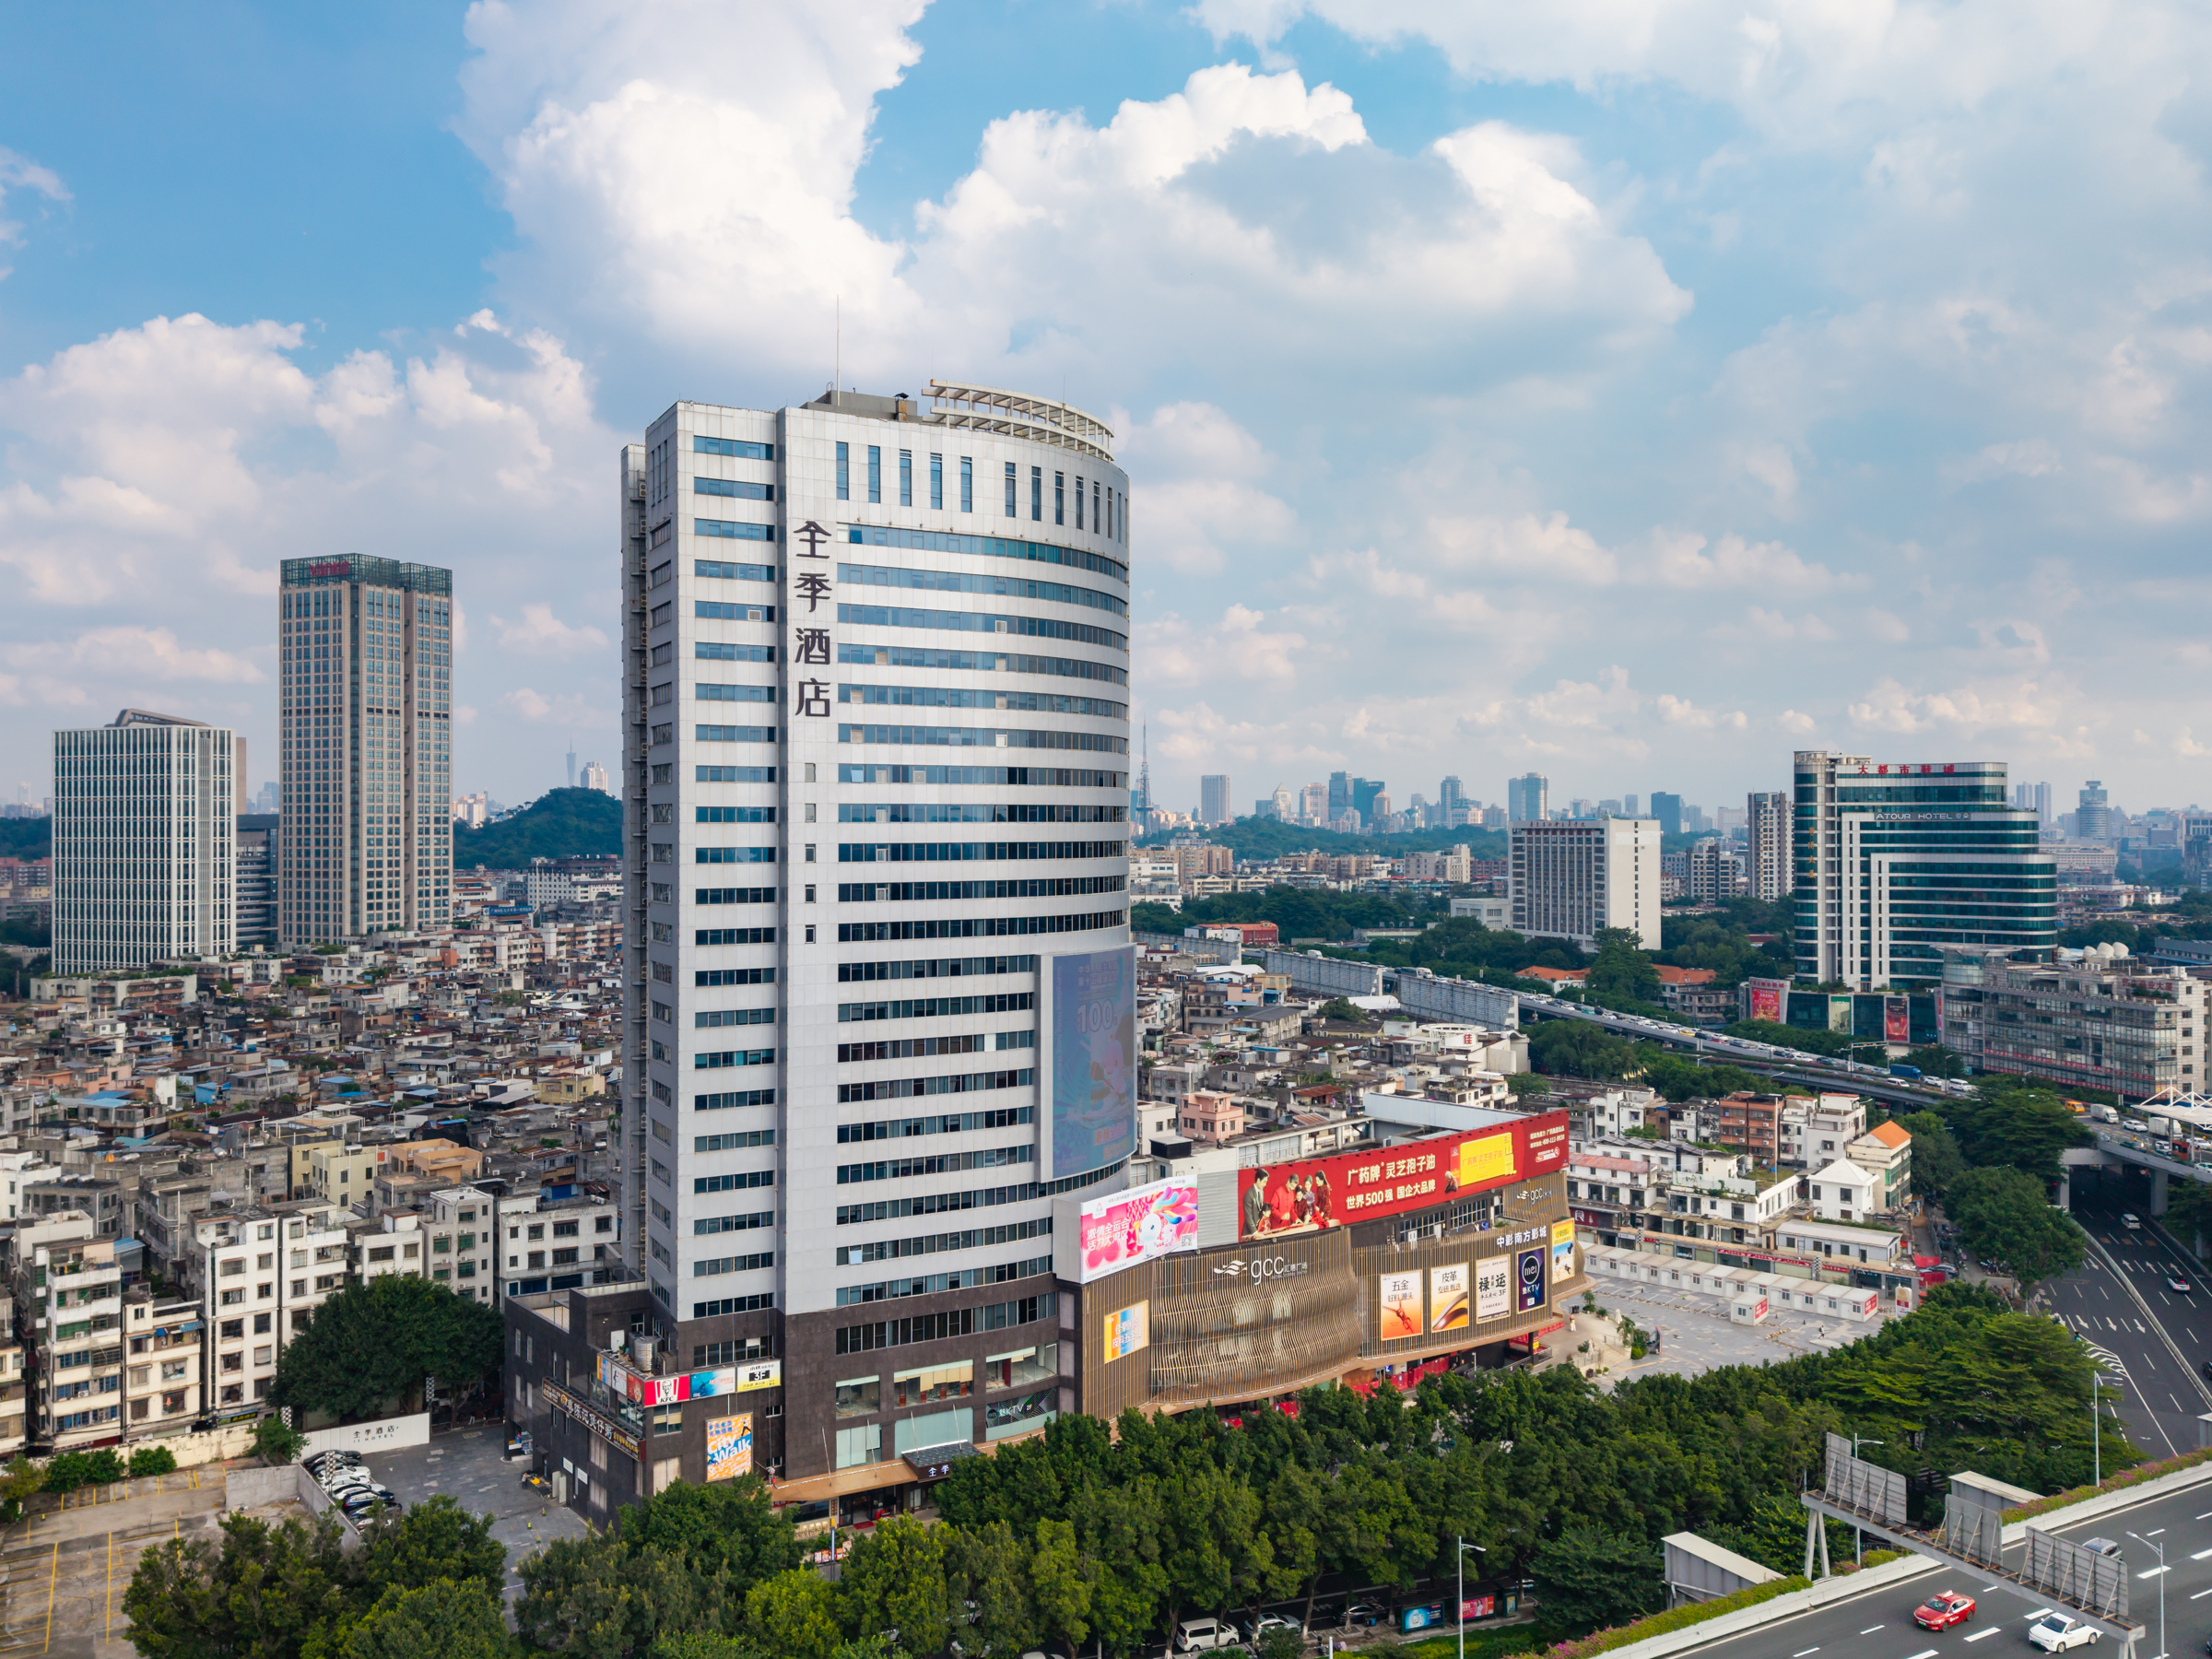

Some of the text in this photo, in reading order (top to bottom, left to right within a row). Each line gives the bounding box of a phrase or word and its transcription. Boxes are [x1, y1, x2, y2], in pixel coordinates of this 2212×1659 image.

[794, 520, 832, 717] 全季酒店
[1858, 764, 1955, 774] 大都市鞋城
[1077, 999, 1113, 1033] 100
[1346, 1179, 1436, 1210] 世界500强 国企大品牌
[1496, 1225, 1547, 1248] 中影南方影城
[1251, 1256, 1284, 1286] gcc
[1441, 1270, 1457, 1283] 皮革
[1392, 1279, 1409, 1291] 五金
[754, 1371, 766, 1381] 3F
[353, 1425, 394, 1438] 全季酒店
[364, 1433, 394, 1441] HOTEL
[707, 1434, 737, 1454] City
[713, 1439, 751, 1463] Walk
